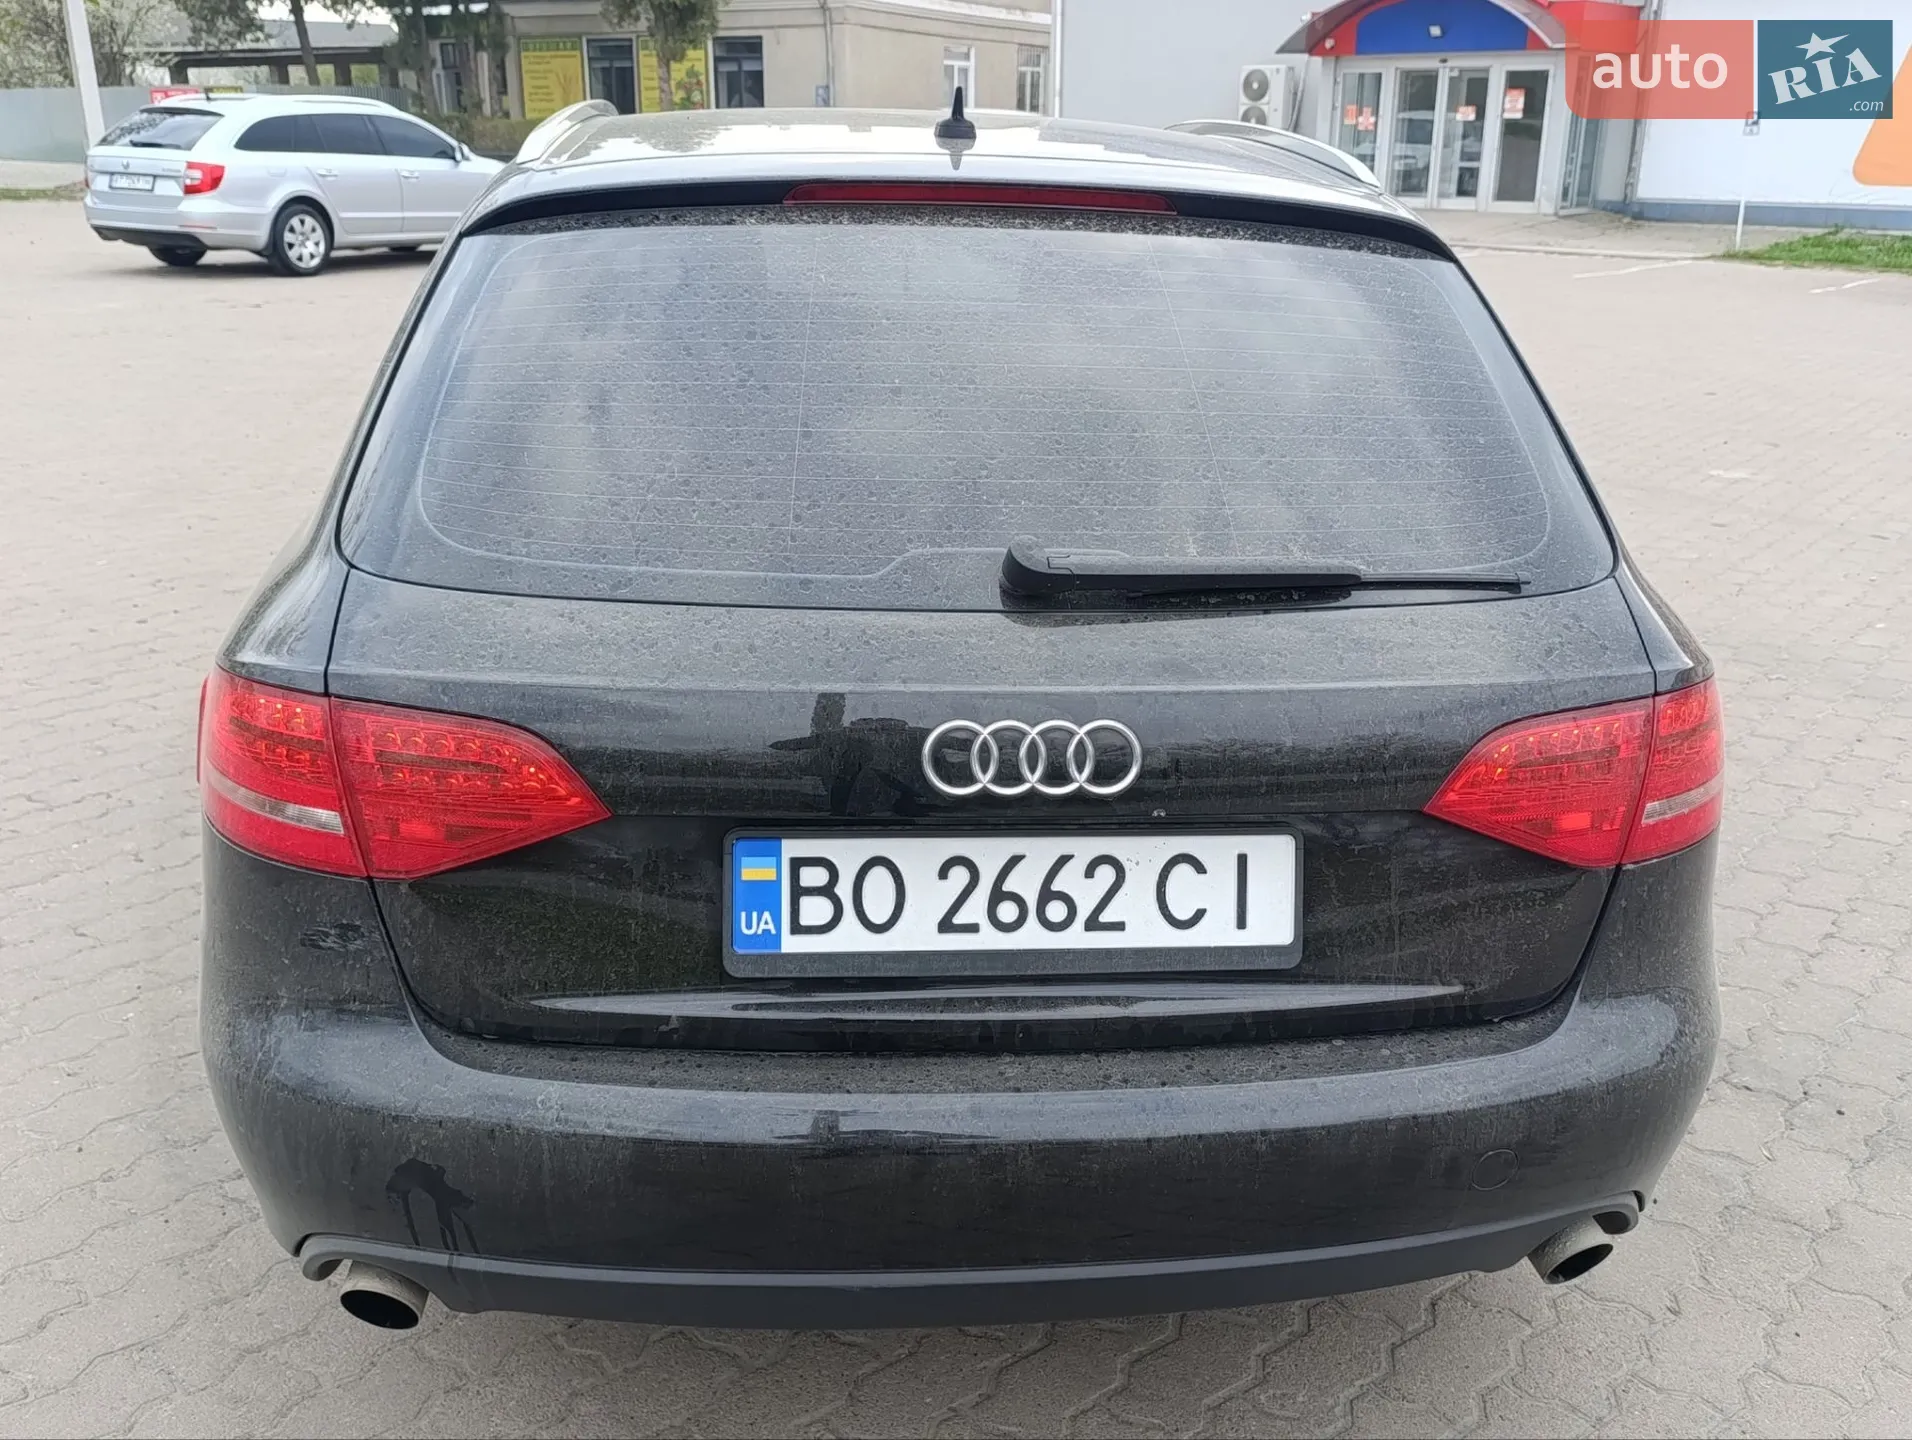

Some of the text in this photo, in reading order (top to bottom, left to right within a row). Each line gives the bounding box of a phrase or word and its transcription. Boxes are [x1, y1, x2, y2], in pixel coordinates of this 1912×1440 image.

[789, 852, 1248, 936] BO 2662 CI
[740, 910, 777, 935] UA
